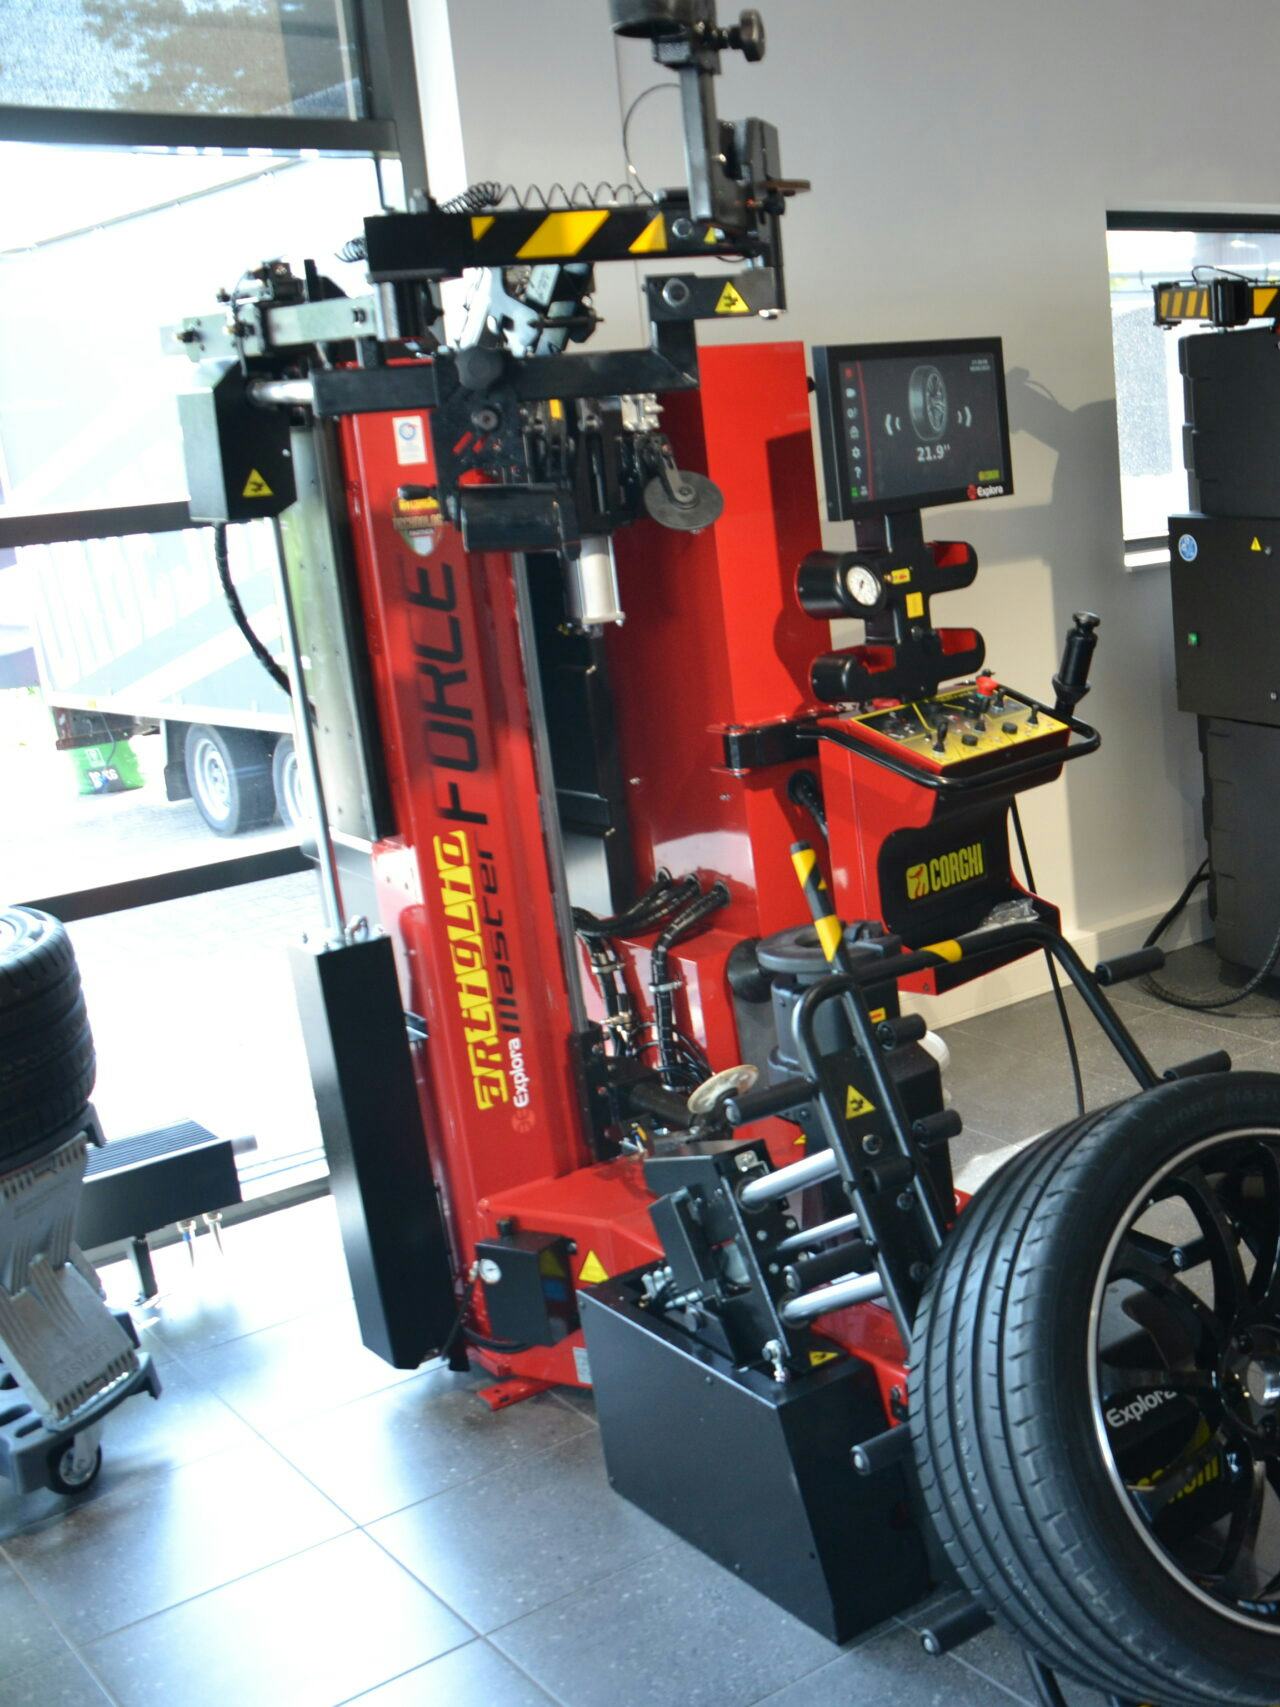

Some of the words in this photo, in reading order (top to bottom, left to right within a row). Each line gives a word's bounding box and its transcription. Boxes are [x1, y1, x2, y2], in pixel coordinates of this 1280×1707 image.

[976, 484, 1004, 498] Explora
[403, 557, 488, 826] FORCE
[929, 843, 984, 892] CORGHI
[512, 1037, 532, 1109] Explora
[1106, 1390, 1178, 1428] Explora
